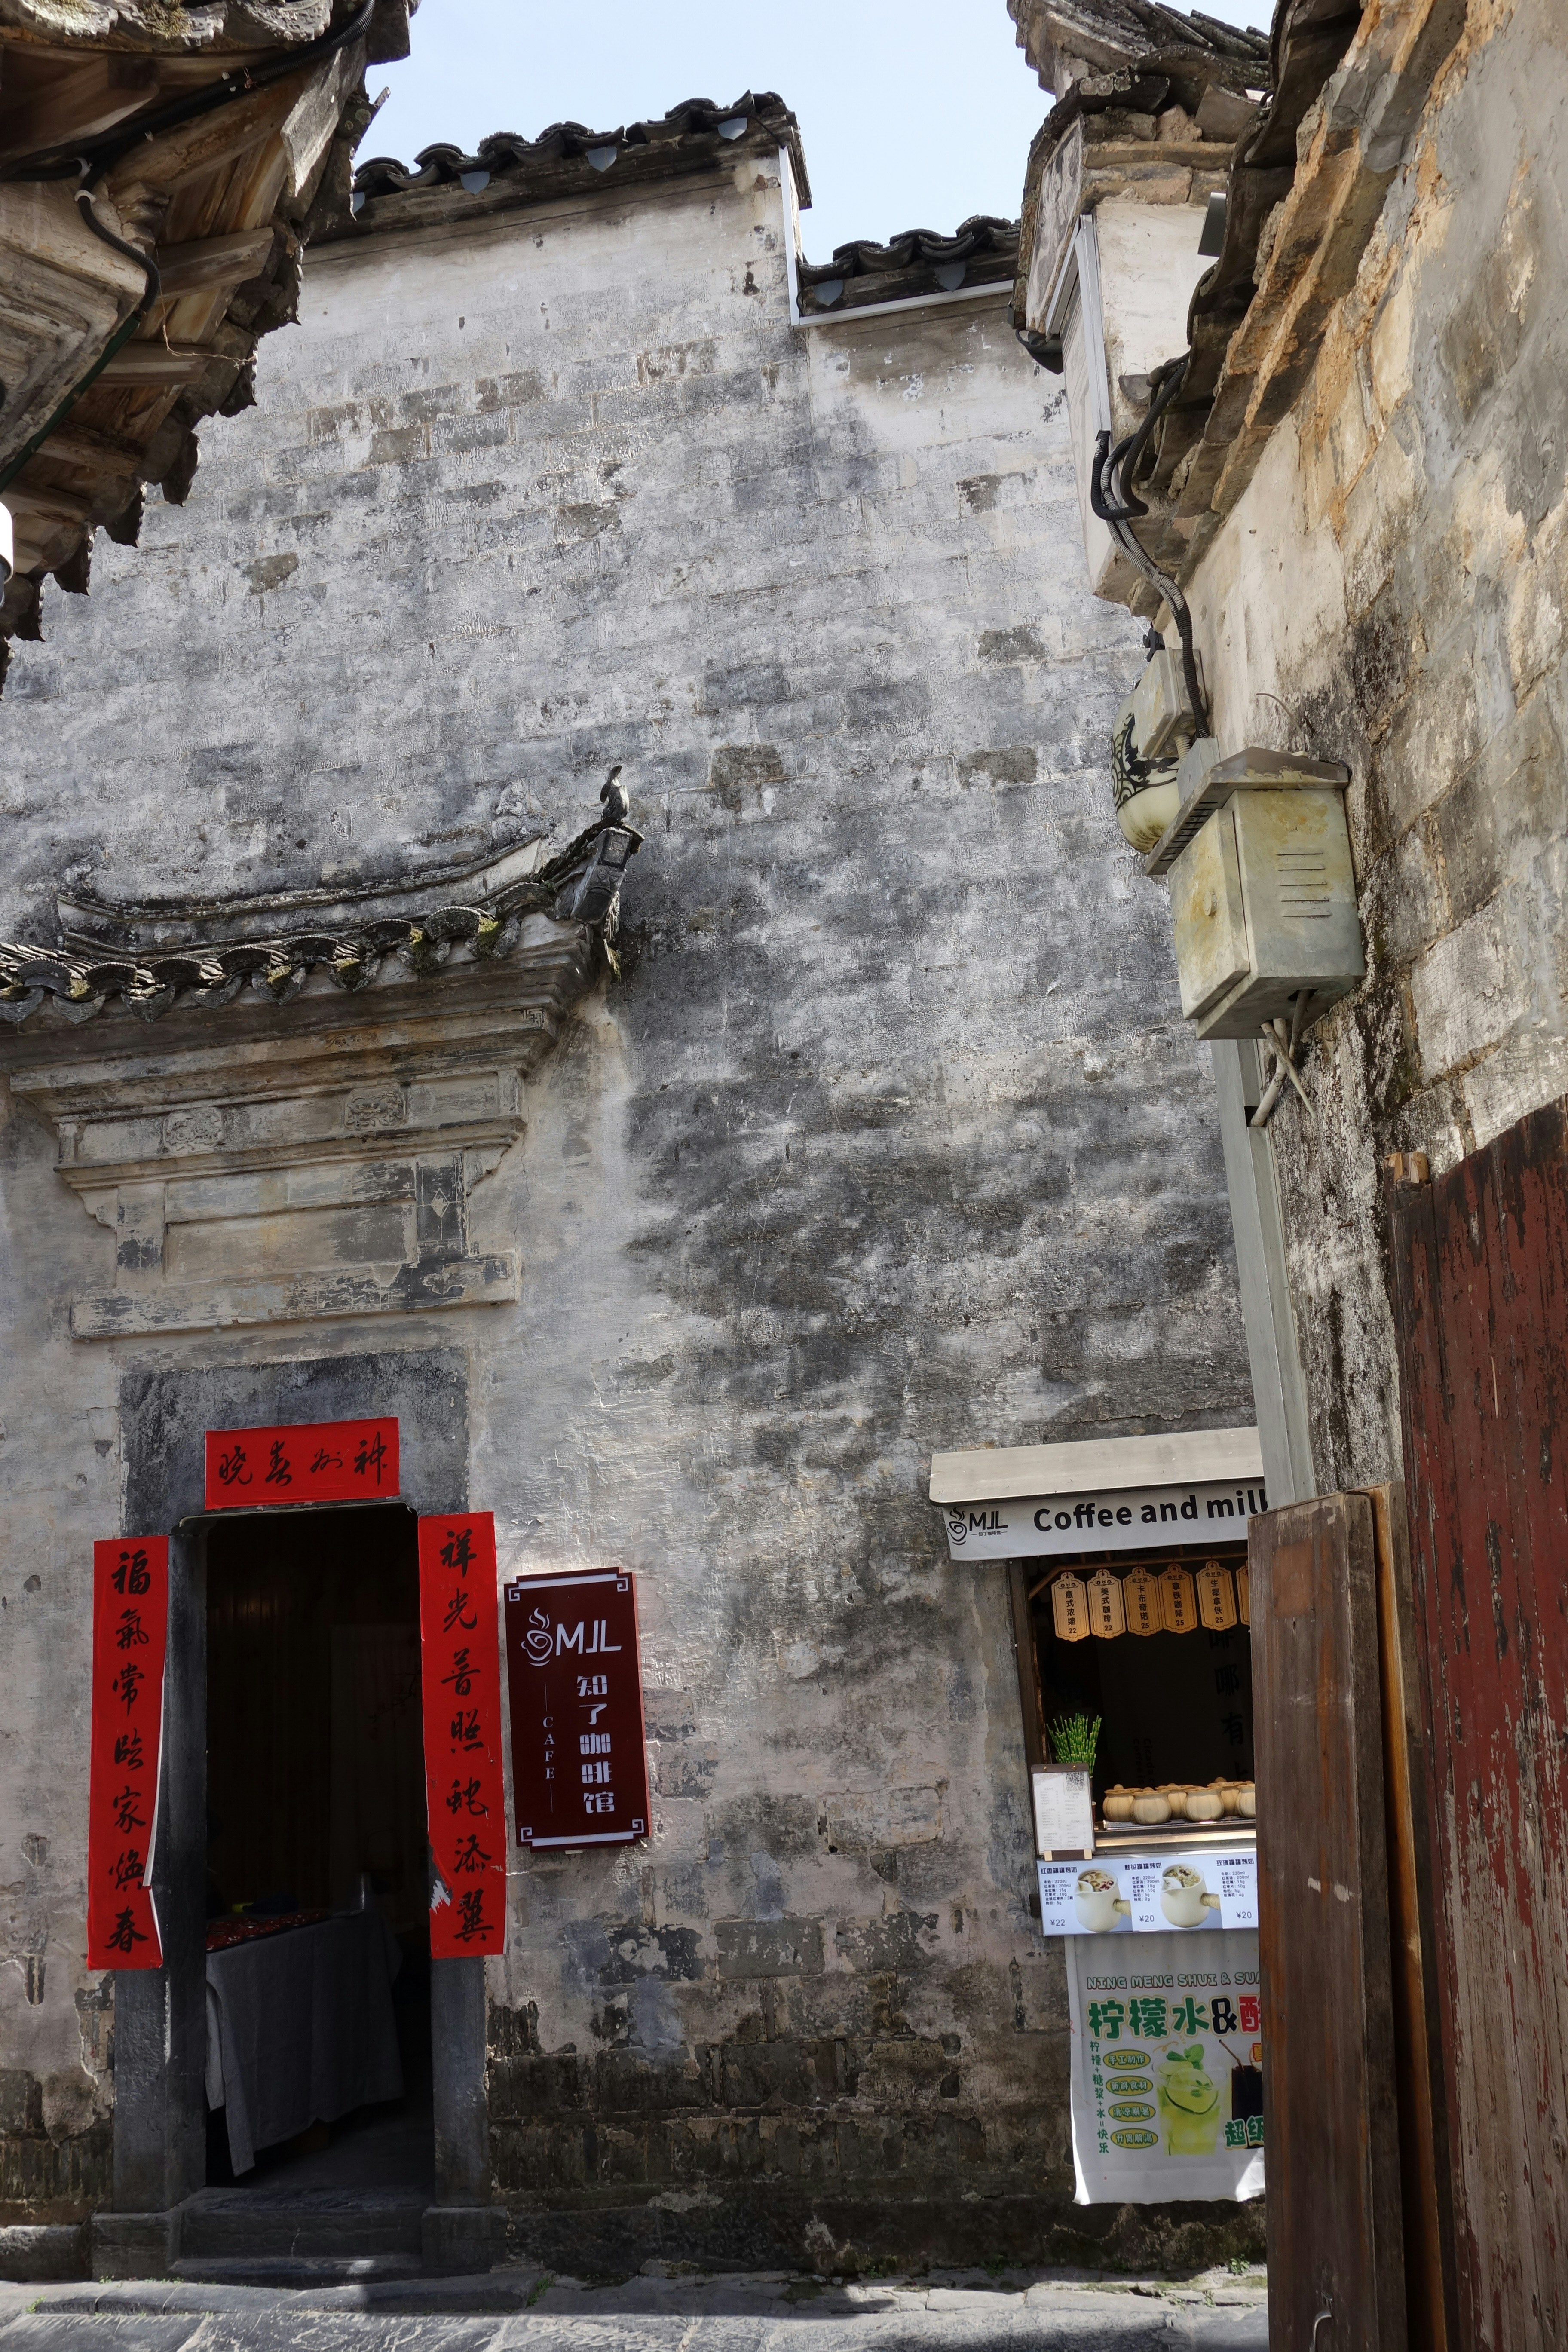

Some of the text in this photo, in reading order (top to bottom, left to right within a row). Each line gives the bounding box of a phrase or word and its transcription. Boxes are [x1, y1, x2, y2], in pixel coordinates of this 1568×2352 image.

[969, 1510, 1008, 1531] MJL
[1034, 1502, 1132, 1532] Coffee
[1140, 1494, 1198, 1523] and
[1065, 1590, 1076, 1626] 意式浓缩
[1100, 1587, 1112, 1623] 美式咖啡
[1137, 1585, 1148, 1620] 卡布奇诺
[1172, 1582, 1183, 1617] 拿铁咖啡
[1210, 1579, 1222, 1615] 生椰拿铁
[555, 1619, 622, 1656] MJL
[542, 1716, 556, 1780] CAFE
[576, 1674, 615, 1815] 知了咖啡馆
[1087, 1976, 1127, 1990] NING
[1131, 1975, 1174, 1988] MENG
[1177, 1973, 1217, 1986] SHUI
[1221, 1972, 1231, 1985] &
[1108, 2055, 1146, 2065] 手工制作
[1110, 2080, 1148, 2091] 新鲜食材
[1113, 2106, 1150, 2117] 清凉解暑
[1115, 2133, 1153, 2144] 开胃解渴
